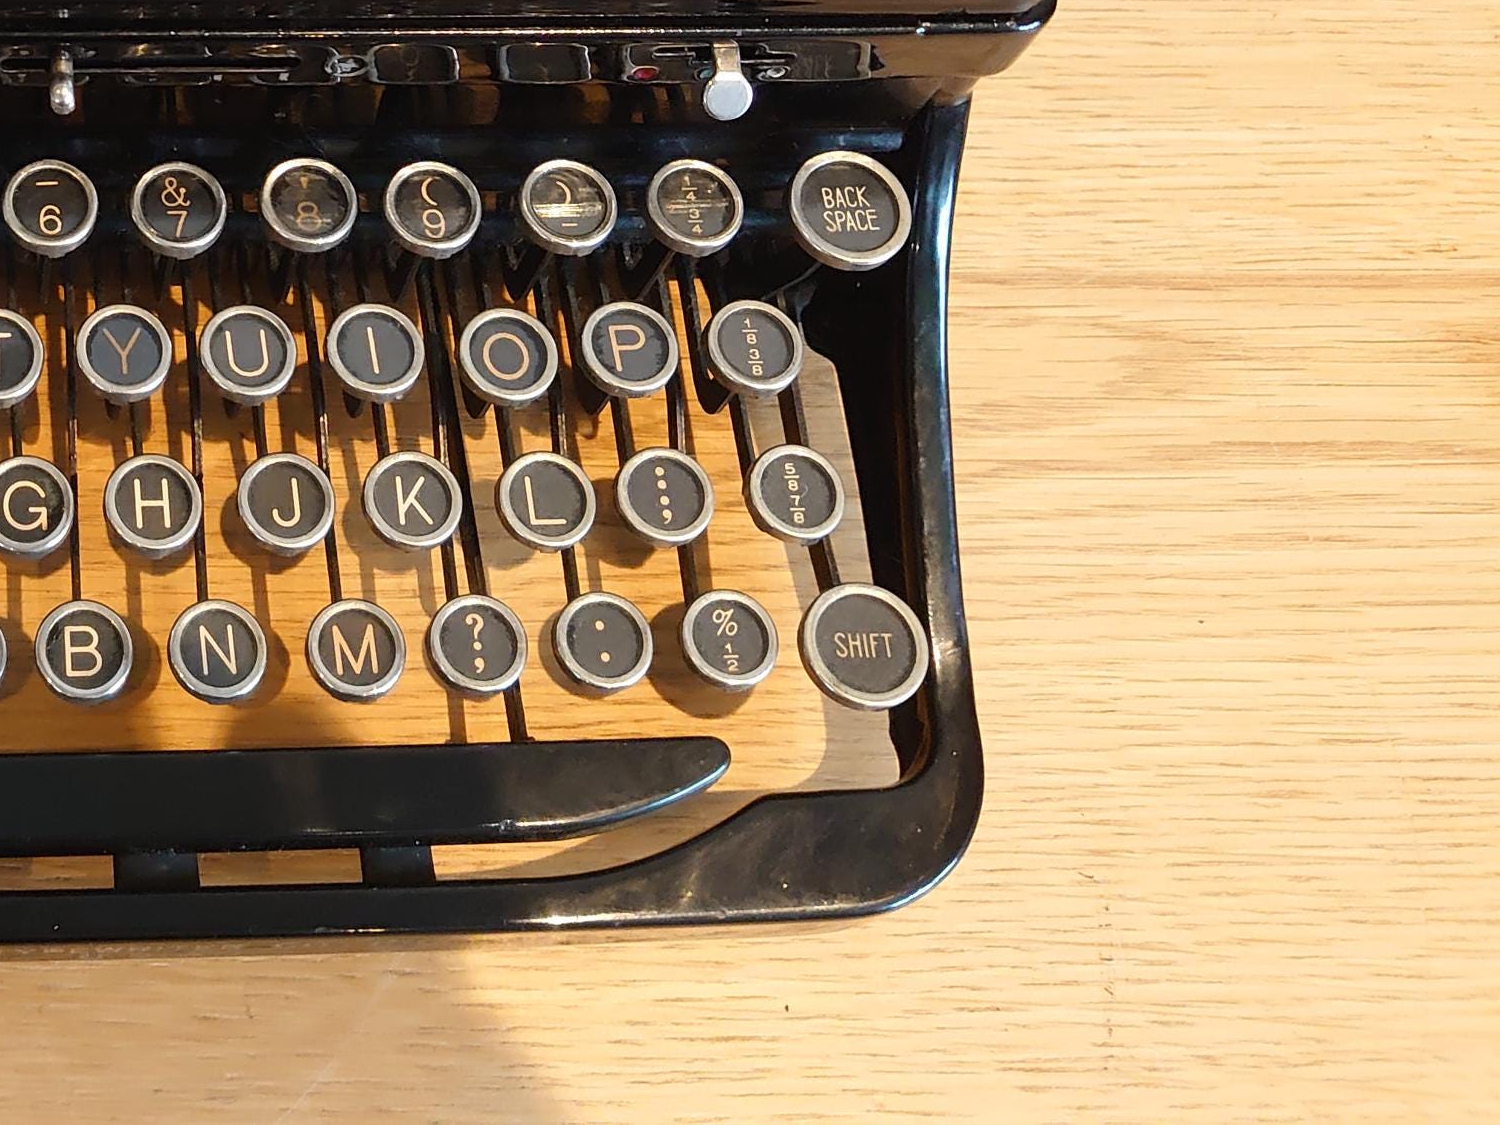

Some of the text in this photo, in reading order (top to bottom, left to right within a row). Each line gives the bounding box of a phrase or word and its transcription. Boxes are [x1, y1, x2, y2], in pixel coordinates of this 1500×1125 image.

[162, 177, 190, 206] &
[821, 186, 870, 208] BACK
[40, 205, 61, 234] 6
[167, 211, 187, 237] 7
[297, 201, 322, 232] 8
[423, 209, 445, 238] 9
[824, 208, 881, 233] SPACE
[103, 328, 140, 374] Y
[225, 330, 268, 376] U
[367, 327, 379, 374] I
[483, 332, 529, 380] O
[608, 325, 645, 372] P
[3, 481, 47, 530] G
[133, 478, 171, 529] H
[273, 478, 300, 527] J
[396, 476, 433, 525] K
[523, 476, 567, 526] L
[713, 609, 737, 635] %
[835, 633, 892, 657] SHIFT
[65, 626, 102, 676] B
[200, 624, 236, 675] N
[332, 624, 378, 675] M
